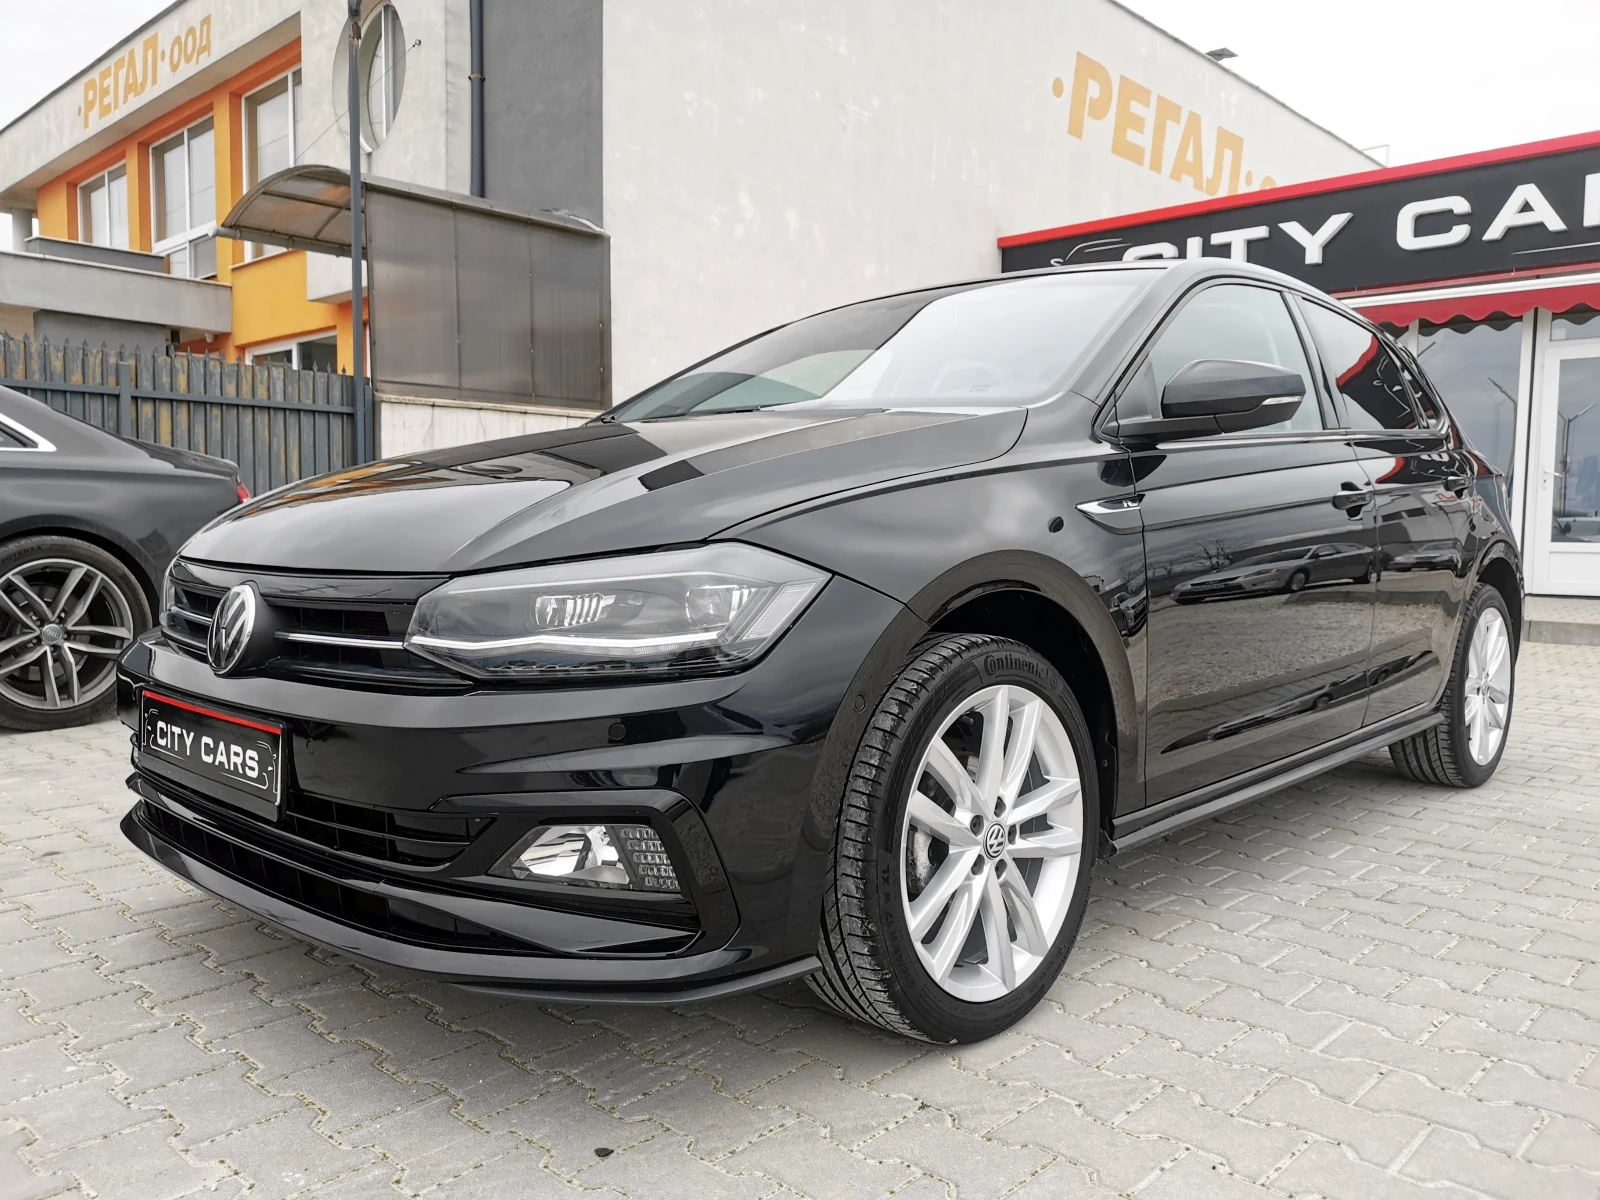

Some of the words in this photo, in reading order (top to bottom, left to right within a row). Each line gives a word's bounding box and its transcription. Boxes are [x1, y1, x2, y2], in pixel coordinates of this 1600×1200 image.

[83, 31, 159, 130] РЕГАЛ
[1067, 51, 1244, 197] РЕГАЛ
[1396, 172, 1600, 252] CA
[156, 720, 195, 756] CITY
[201, 735, 259, 779] CARS
